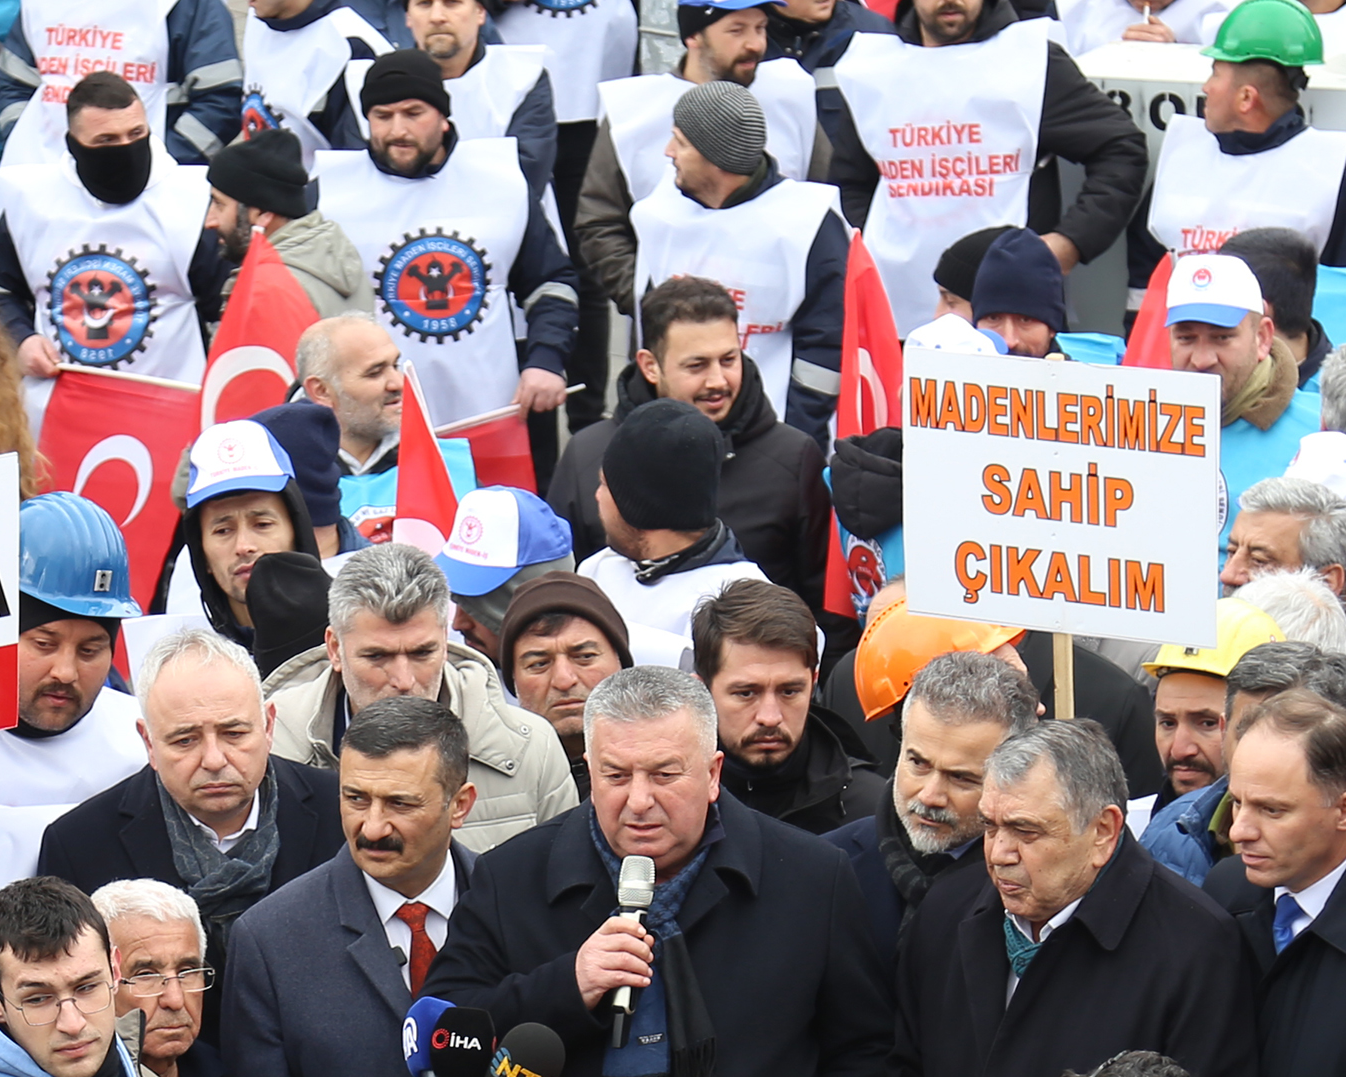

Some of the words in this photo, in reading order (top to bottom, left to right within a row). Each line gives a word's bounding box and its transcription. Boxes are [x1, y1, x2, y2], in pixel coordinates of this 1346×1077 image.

[45, 24, 124, 50] TÜRKİYE
[889, 120, 982, 148] TÜRKİYE
[931, 148, 1021, 182] İŞÇİLERİ
[395, 244, 426, 269] MADEN
[909, 377, 1206, 457] MADENLERİMİZE
[982, 463, 1134, 527] SAHİP
[955, 541, 1165, 613] ÇIKALIM
[450, 1032, 482, 1051] İHA
